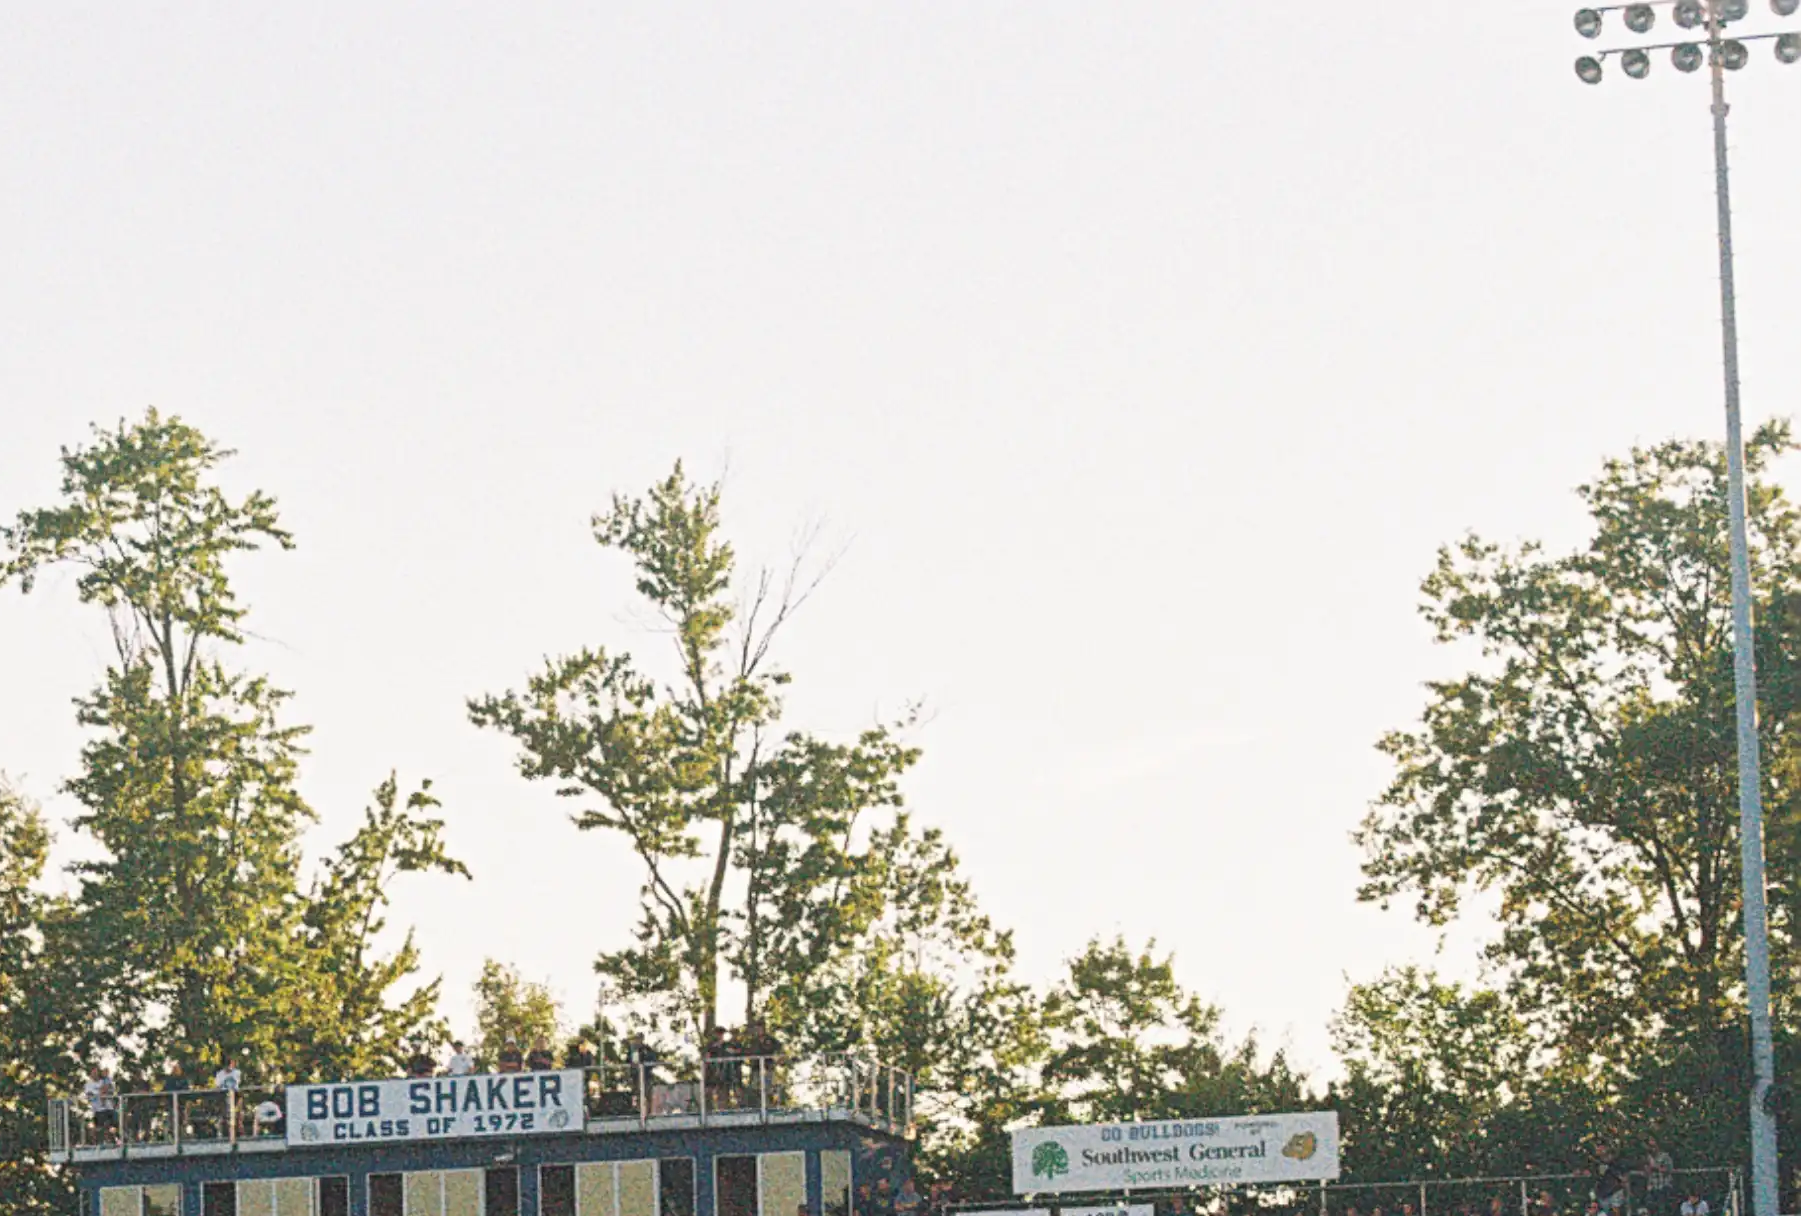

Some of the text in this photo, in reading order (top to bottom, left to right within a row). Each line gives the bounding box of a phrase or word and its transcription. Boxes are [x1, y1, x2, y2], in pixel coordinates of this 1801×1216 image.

[306, 1074, 563, 1120] BOB SHAKER
[333, 1113, 535, 1140] CLASS OF 1972
[1082, 1140, 1266, 1167] Southwest General
[1125, 1164, 1242, 1184] Sports Medicine
